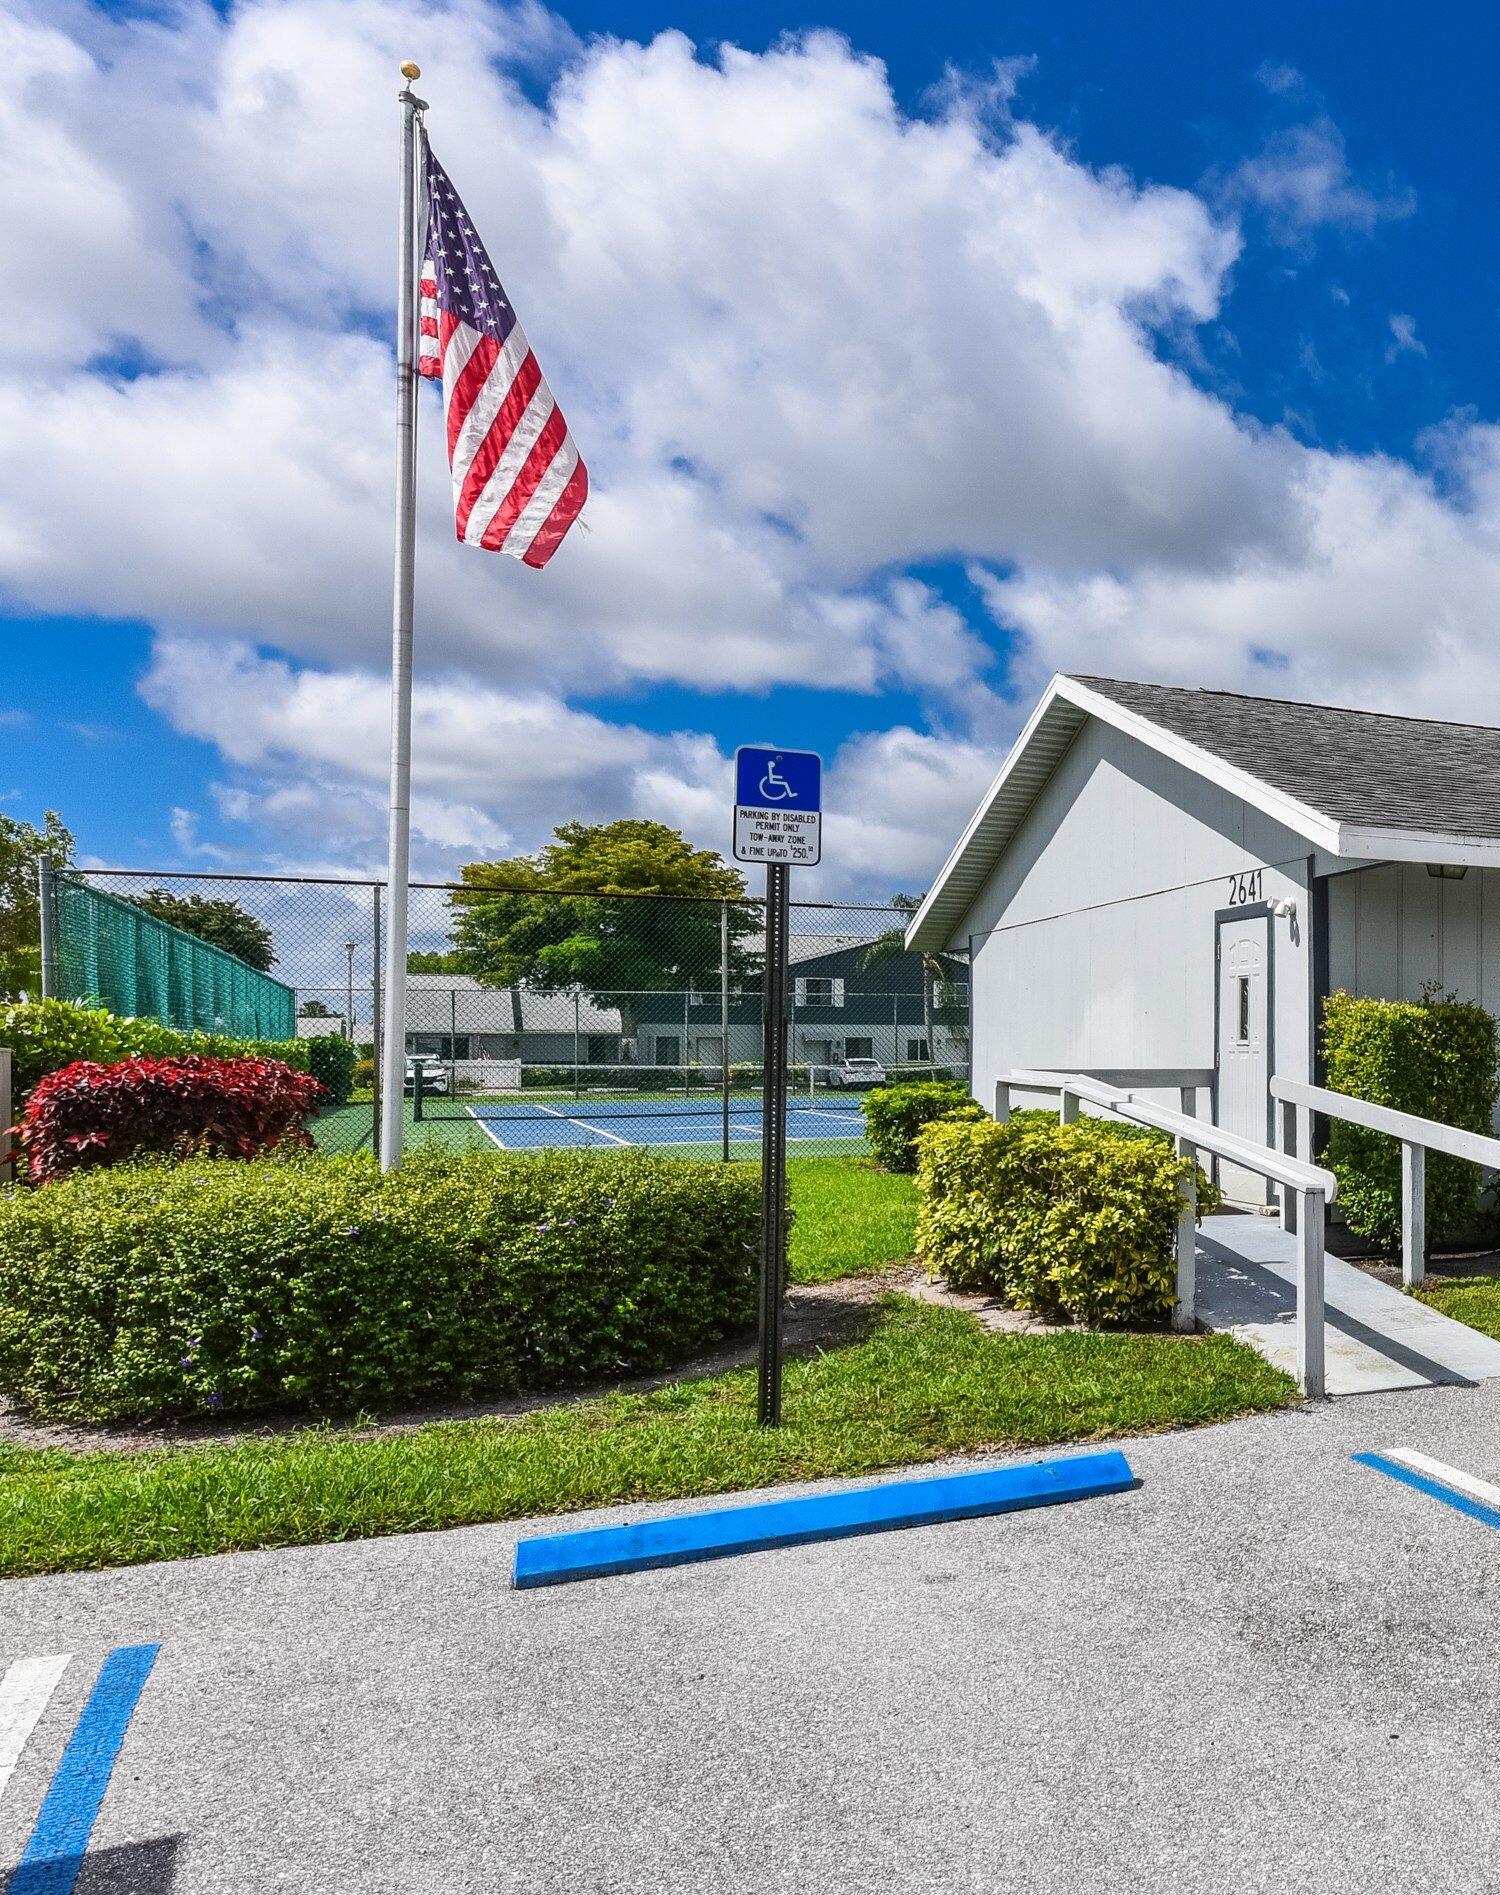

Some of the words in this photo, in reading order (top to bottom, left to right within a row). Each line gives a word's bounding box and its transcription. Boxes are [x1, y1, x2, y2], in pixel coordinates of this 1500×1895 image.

[740, 810, 769, 821] PARKING
[771, 812, 780, 821] BY
[783, 813, 816, 824] DISABLED
[756, 821, 780, 830] PERMIT
[783, 823, 800, 833] ONLY
[750, 832, 785, 843] TOW-AWAY
[788, 835, 806, 845] ZONE
[749, 846, 765, 856] FINE
[1229, 869, 1262, 905] 2641
